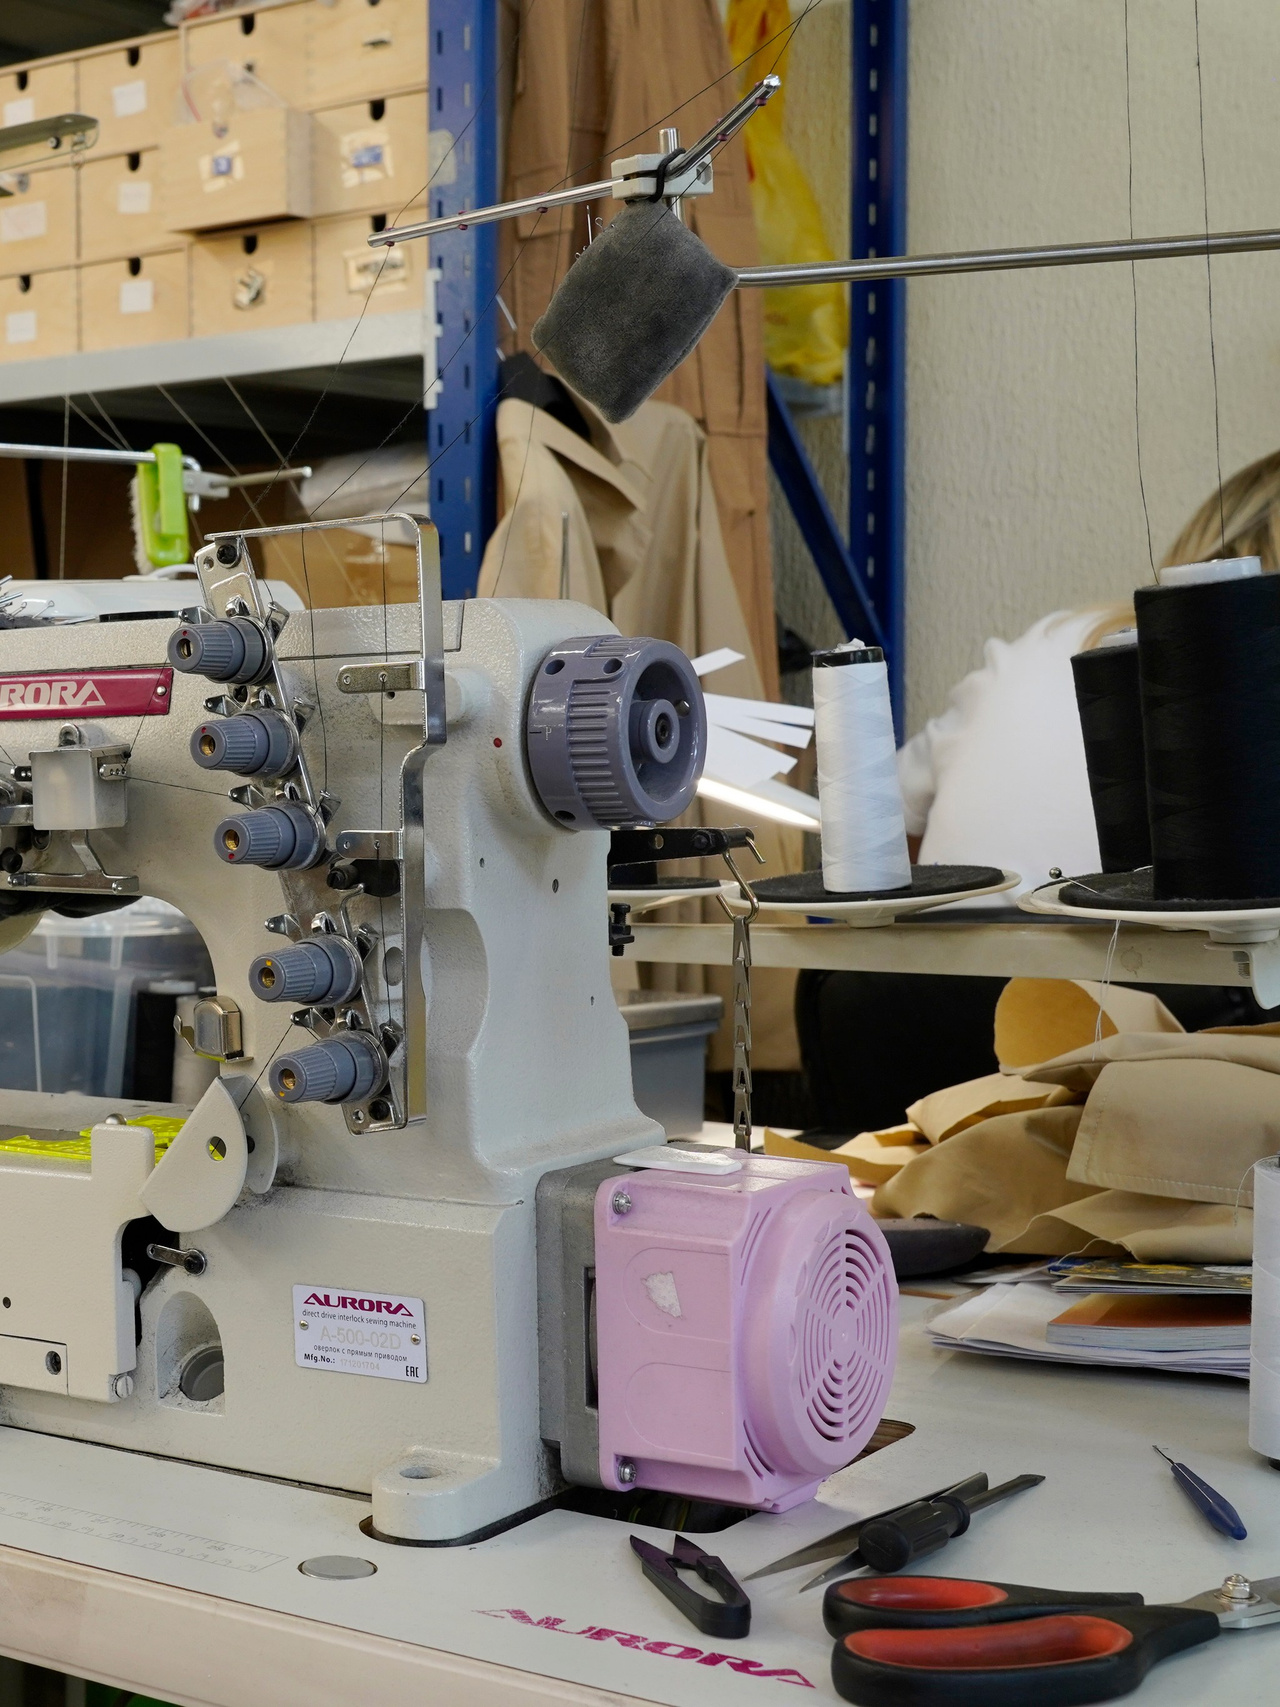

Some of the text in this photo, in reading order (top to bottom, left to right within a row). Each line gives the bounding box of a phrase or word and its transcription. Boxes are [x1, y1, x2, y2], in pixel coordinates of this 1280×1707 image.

[303, 1292, 414, 1317] AURORA
[302, 1309, 417, 1329] direct drive interlock sewing machine
[320, 1325, 401, 1350] A-500-02D
[313, 1344, 340, 1354] оверлок
[346, 1349, 373, 1358] прямым
[374, 1352, 408, 1362] приводом
[405, 1365, 419, 1378] EAC
[471, 1608, 816, 1689] AURORA
